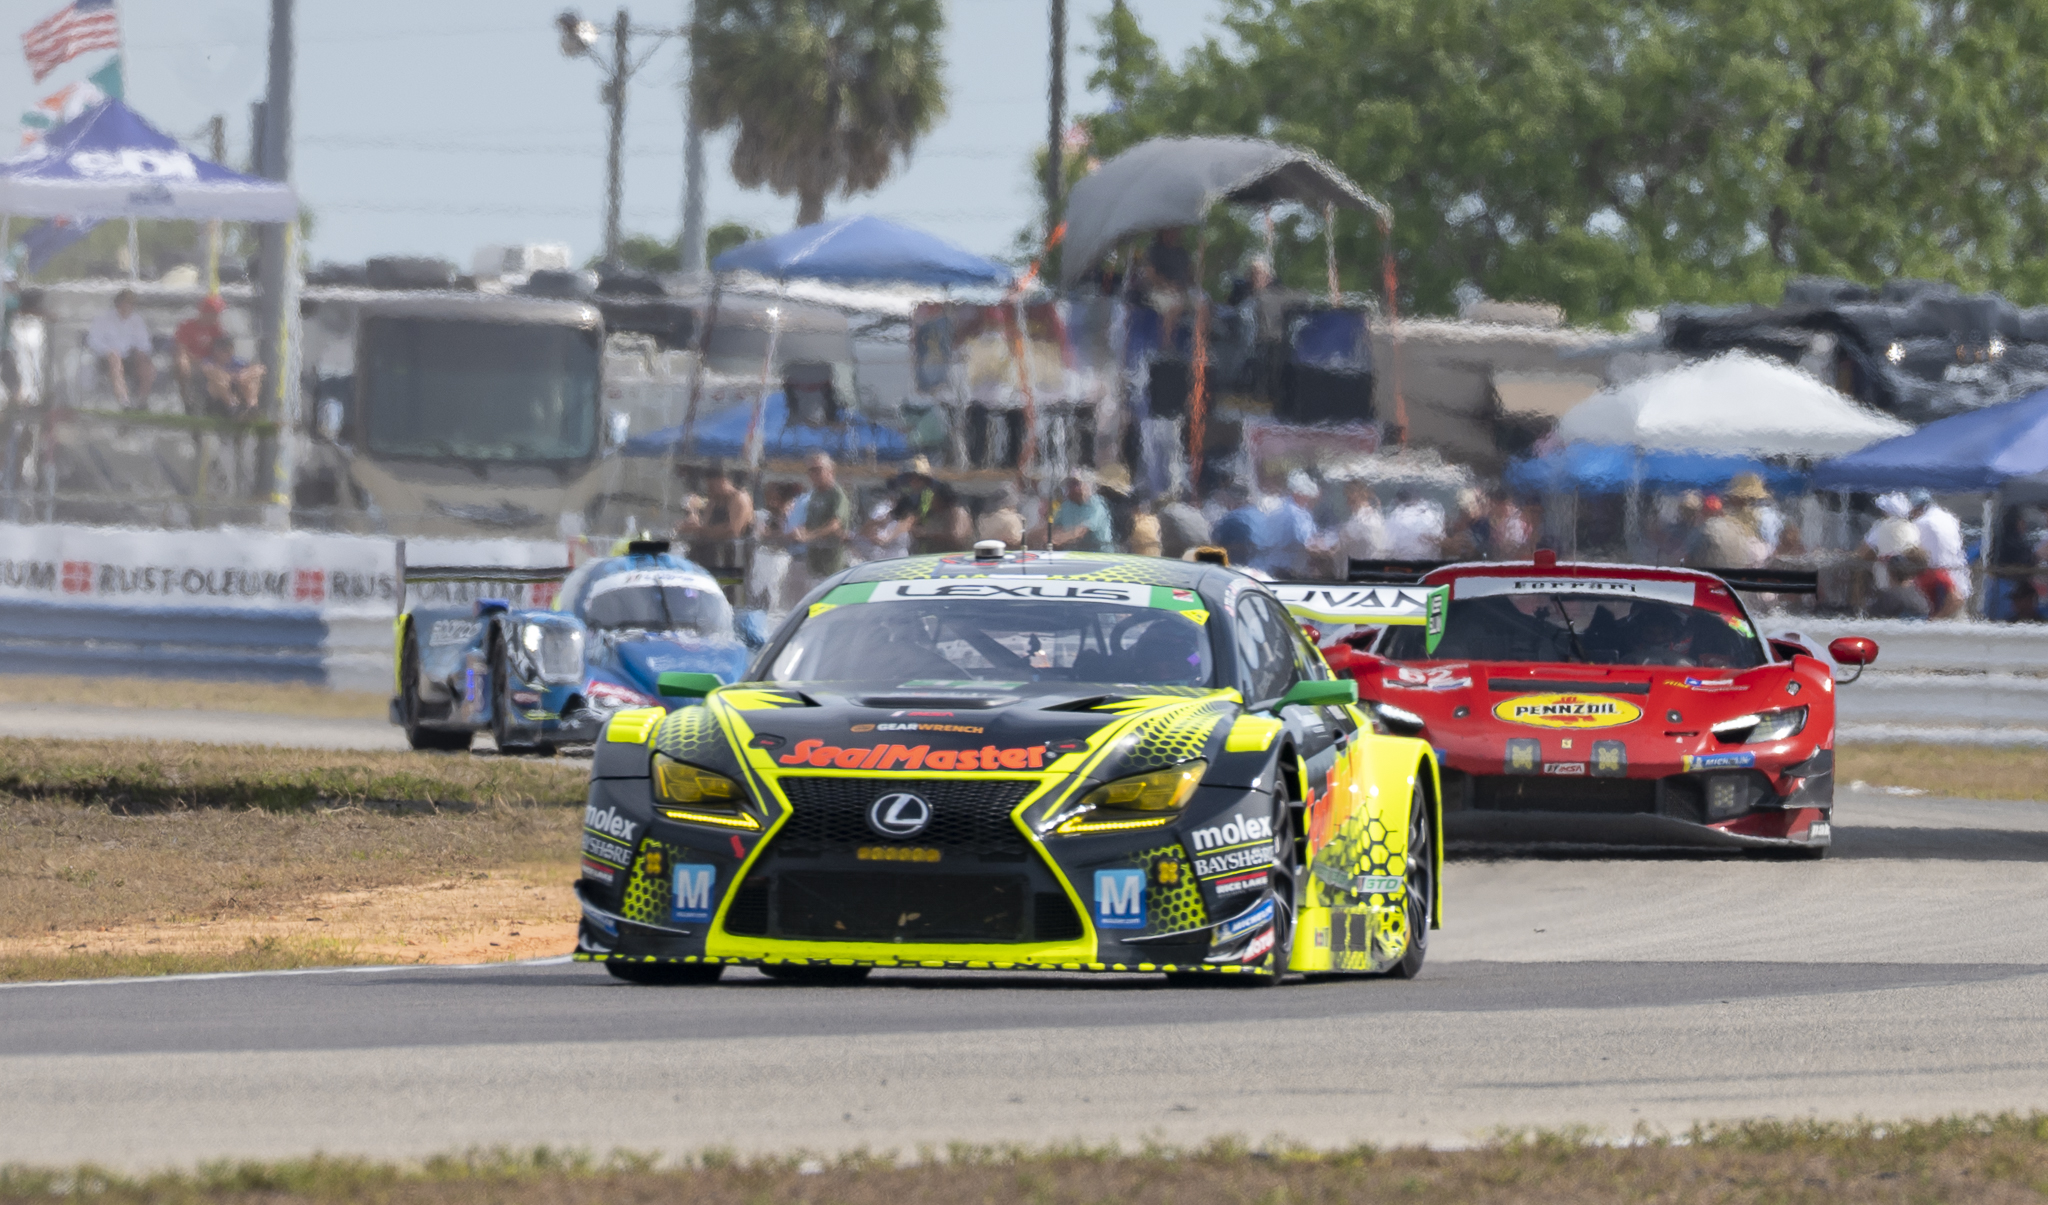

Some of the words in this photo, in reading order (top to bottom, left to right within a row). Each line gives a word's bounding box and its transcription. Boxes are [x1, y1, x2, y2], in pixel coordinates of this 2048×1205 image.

[896, 584, 1131, 601] LEXUS
[1515, 702, 1619, 717] PENNZOIL
[876, 723, 985, 734] GEARWRENCH
[779, 738, 1047, 771] SealMaster
[1191, 813, 1273, 851] molex
[1365, 878, 1399, 890] GTD
[1100, 875, 1140, 915] M
